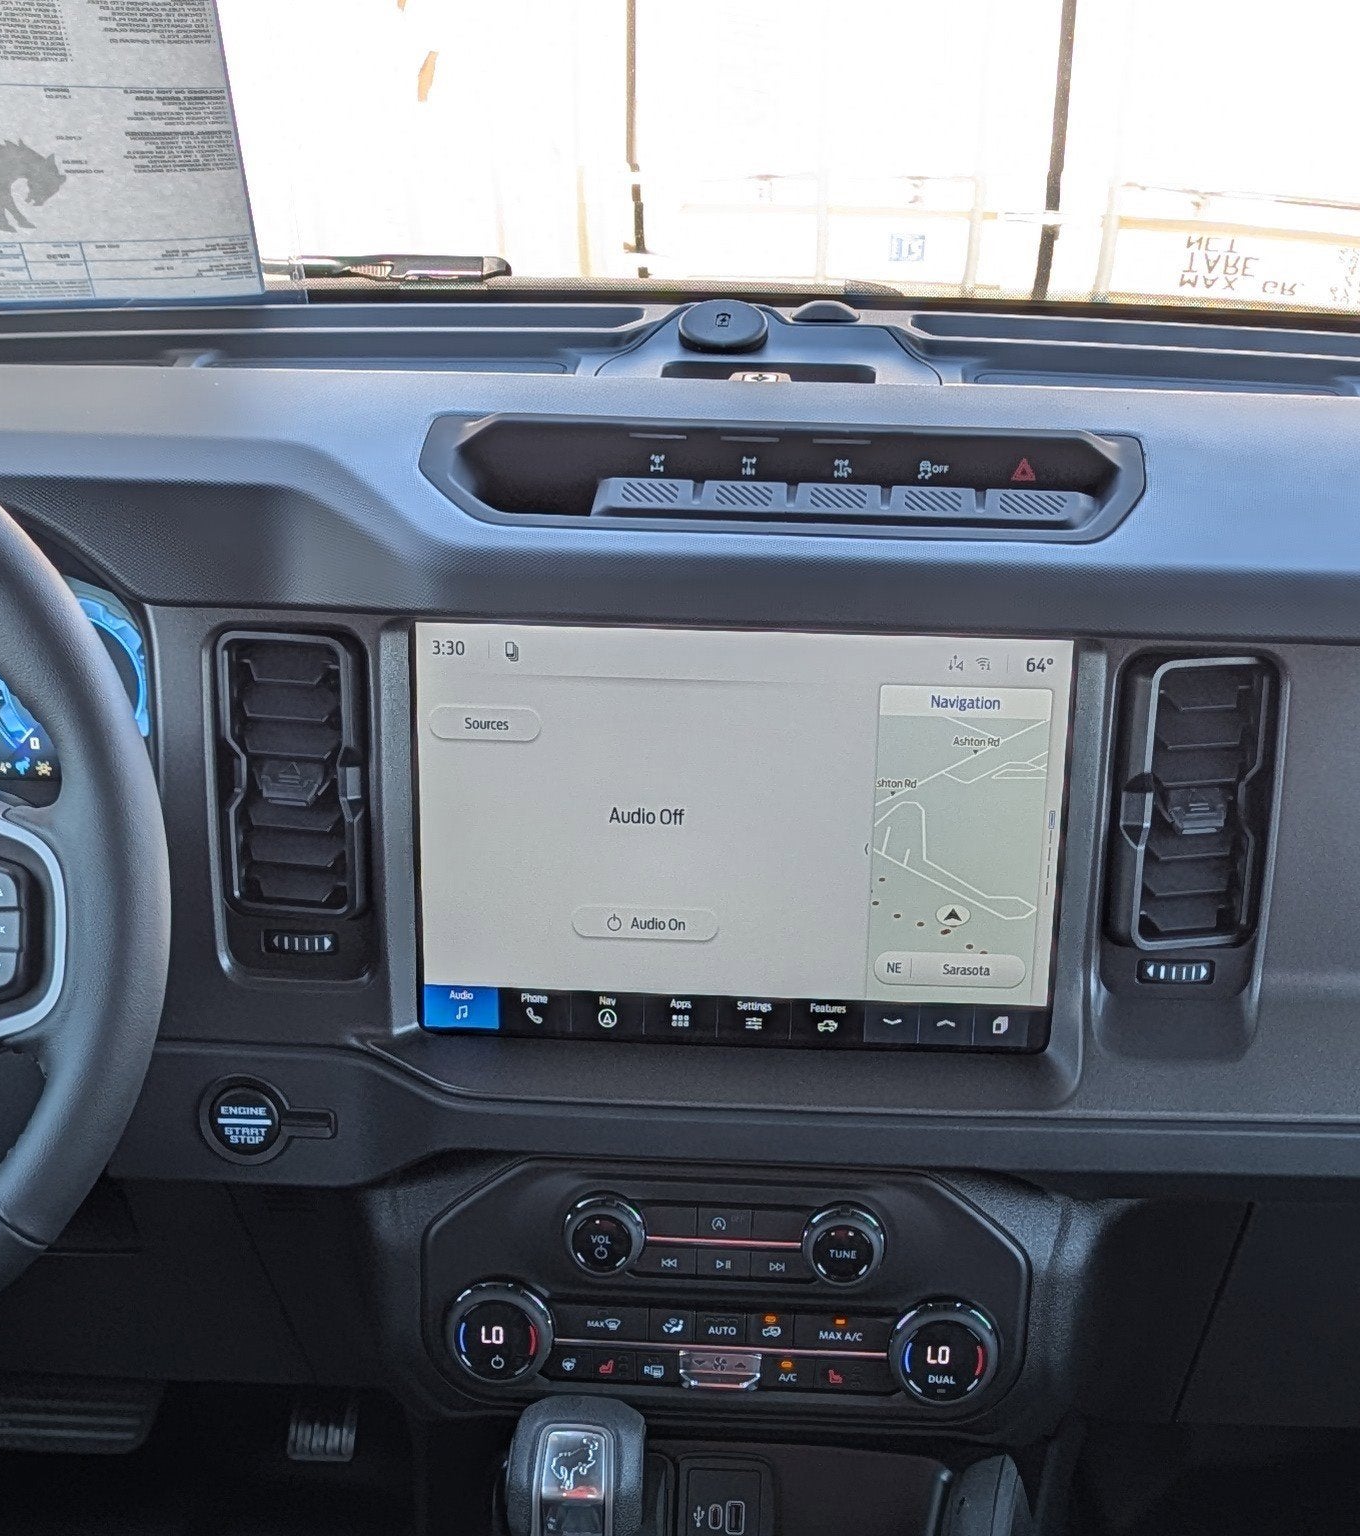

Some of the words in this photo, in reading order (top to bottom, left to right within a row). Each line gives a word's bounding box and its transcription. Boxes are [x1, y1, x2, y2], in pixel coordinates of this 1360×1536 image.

[432, 640, 465, 657] 3:30
[1025, 657, 1054, 674] 64°
[930, 694, 1001, 714] Navigation
[464, 716, 509, 732] Sources
[30, 736, 39, 750] 0
[953, 736, 984, 748] Ashton
[987, 736, 1000, 748] Rd
[876, 779, 902, 789] shton
[904, 778, 918, 789] Rd
[608, 807, 648, 826] Audio
[651, 807, 685, 826] Off
[630, 916, 663, 932] Audio
[666, 917, 686, 932] On
[886, 961, 902, 975] NE
[942, 963, 991, 978] Sarasota
[449, 989, 474, 1001] Audio
[520, 993, 549, 1005] Phone
[598, 995, 617, 1007] Nav
[669, 998, 692, 1011] Apps
[736, 1001, 772, 1014] Settings
[809, 1003, 847, 1015] Features
[221, 1106, 268, 1116] ENGINE
[224, 1127, 267, 1135] START
[229, 1135, 264, 1144] STOP
[590, 1235, 612, 1244] VOL
[828, 1250, 857, 1259] TUNE
[586, 1320, 606, 1328] MAX
[481, 1326, 504, 1346] LO
[708, 1326, 737, 1335] AUTO
[818, 1330, 842, 1340] MAX
[844, 1332, 863, 1342] A/C
[926, 1345, 950, 1364] LO
[778, 1372, 797, 1382] A/C
[928, 1374, 956, 1384] DUAL
